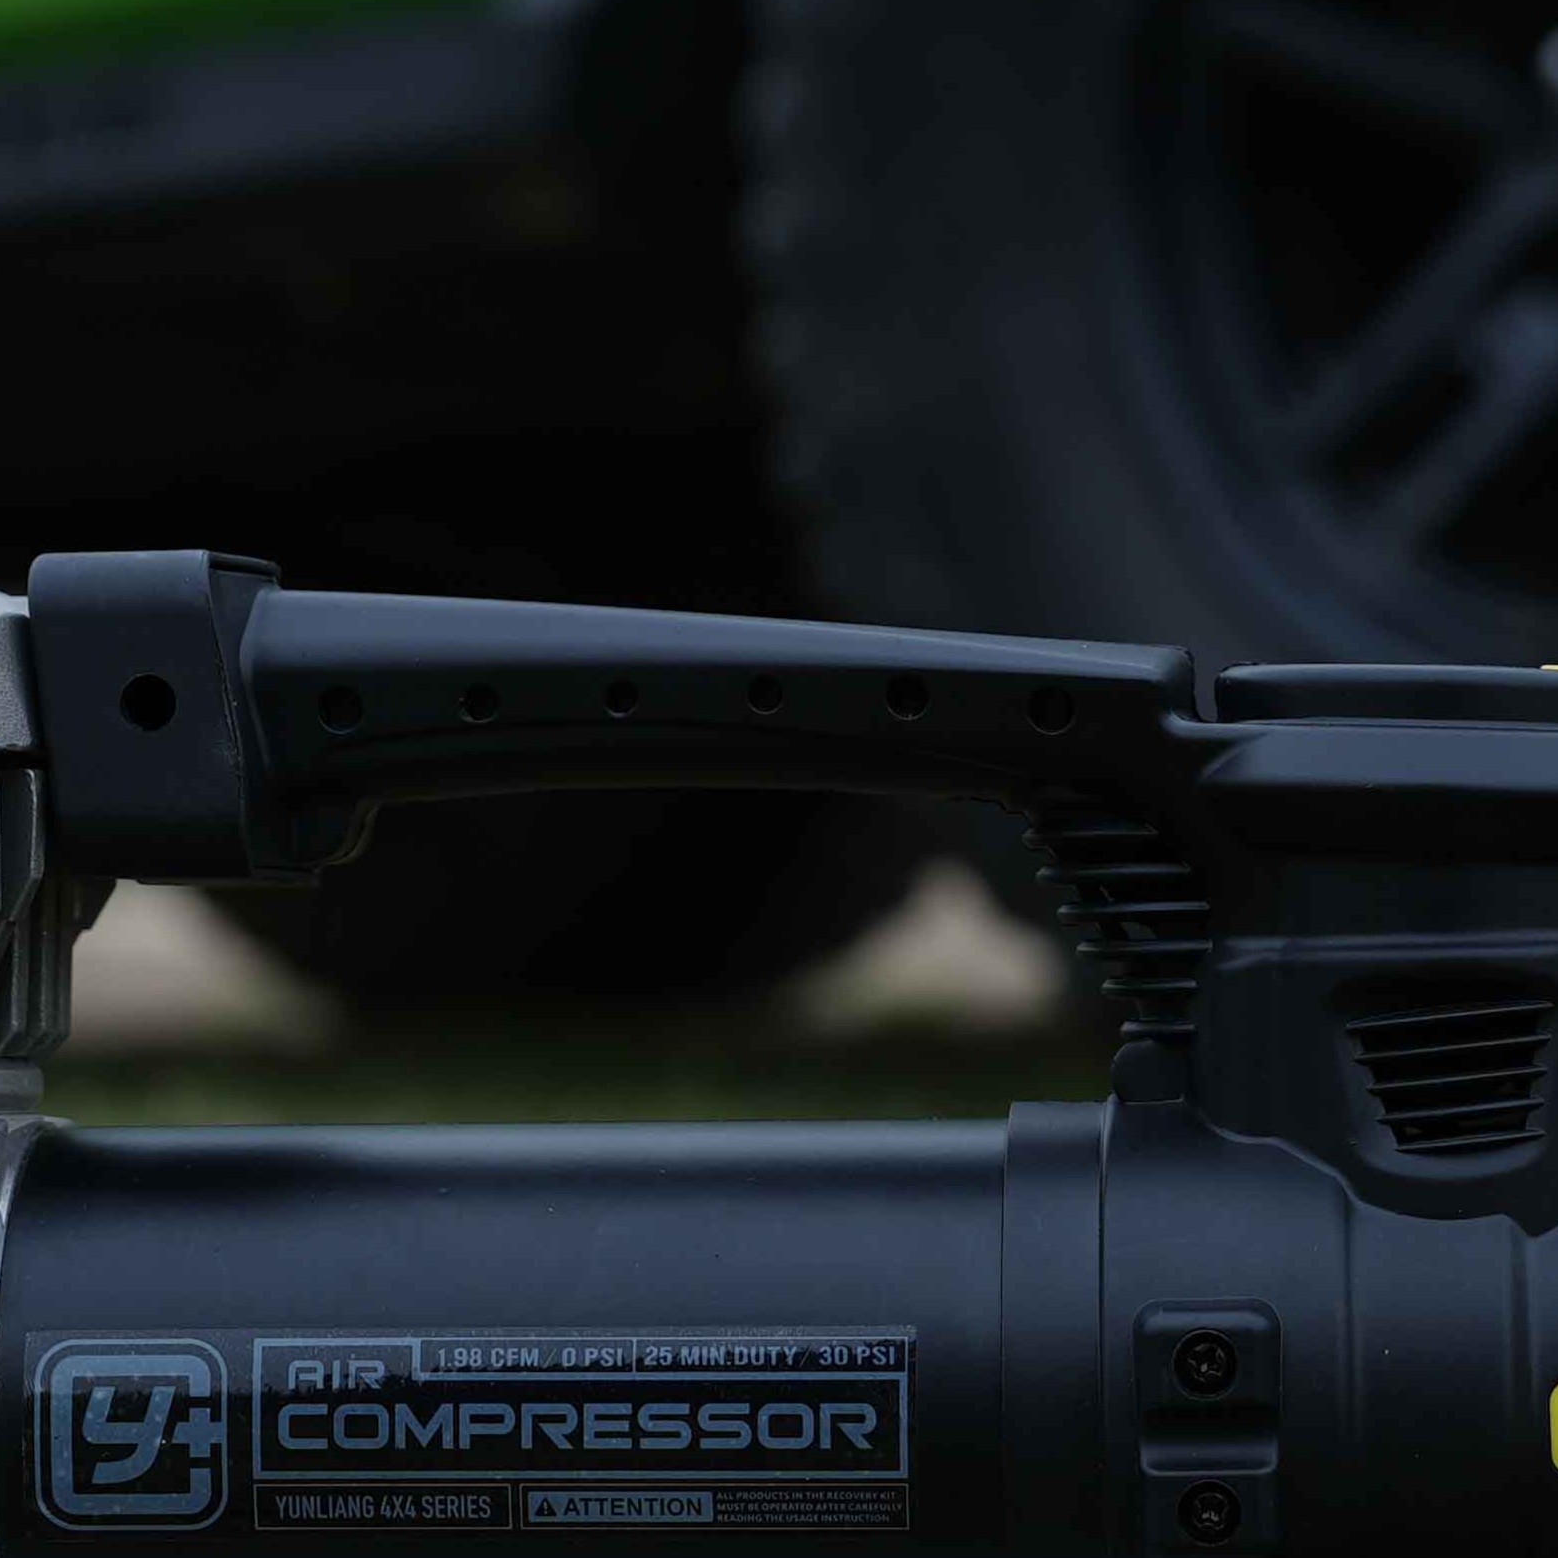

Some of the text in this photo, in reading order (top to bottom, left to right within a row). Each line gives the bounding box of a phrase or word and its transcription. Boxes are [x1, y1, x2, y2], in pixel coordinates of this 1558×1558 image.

[438, 1348, 482, 1368] 1.98
[491, 1347, 539, 1368] CFM
[584, 1348, 623, 1368] PSI
[644, 1345, 672, 1366] 25
[819, 1345, 848, 1366] 30
[856, 1346, 896, 1366] PSI
[288, 1360, 385, 1390] AIR
[278, 1402, 877, 1450] COMPRESSOR
[716, 1491, 734, 1500] ALL
[275, 1496, 491, 1519] YUNLIANG 4X4 SERIES
[563, 1497, 702, 1517] ATTENTION
